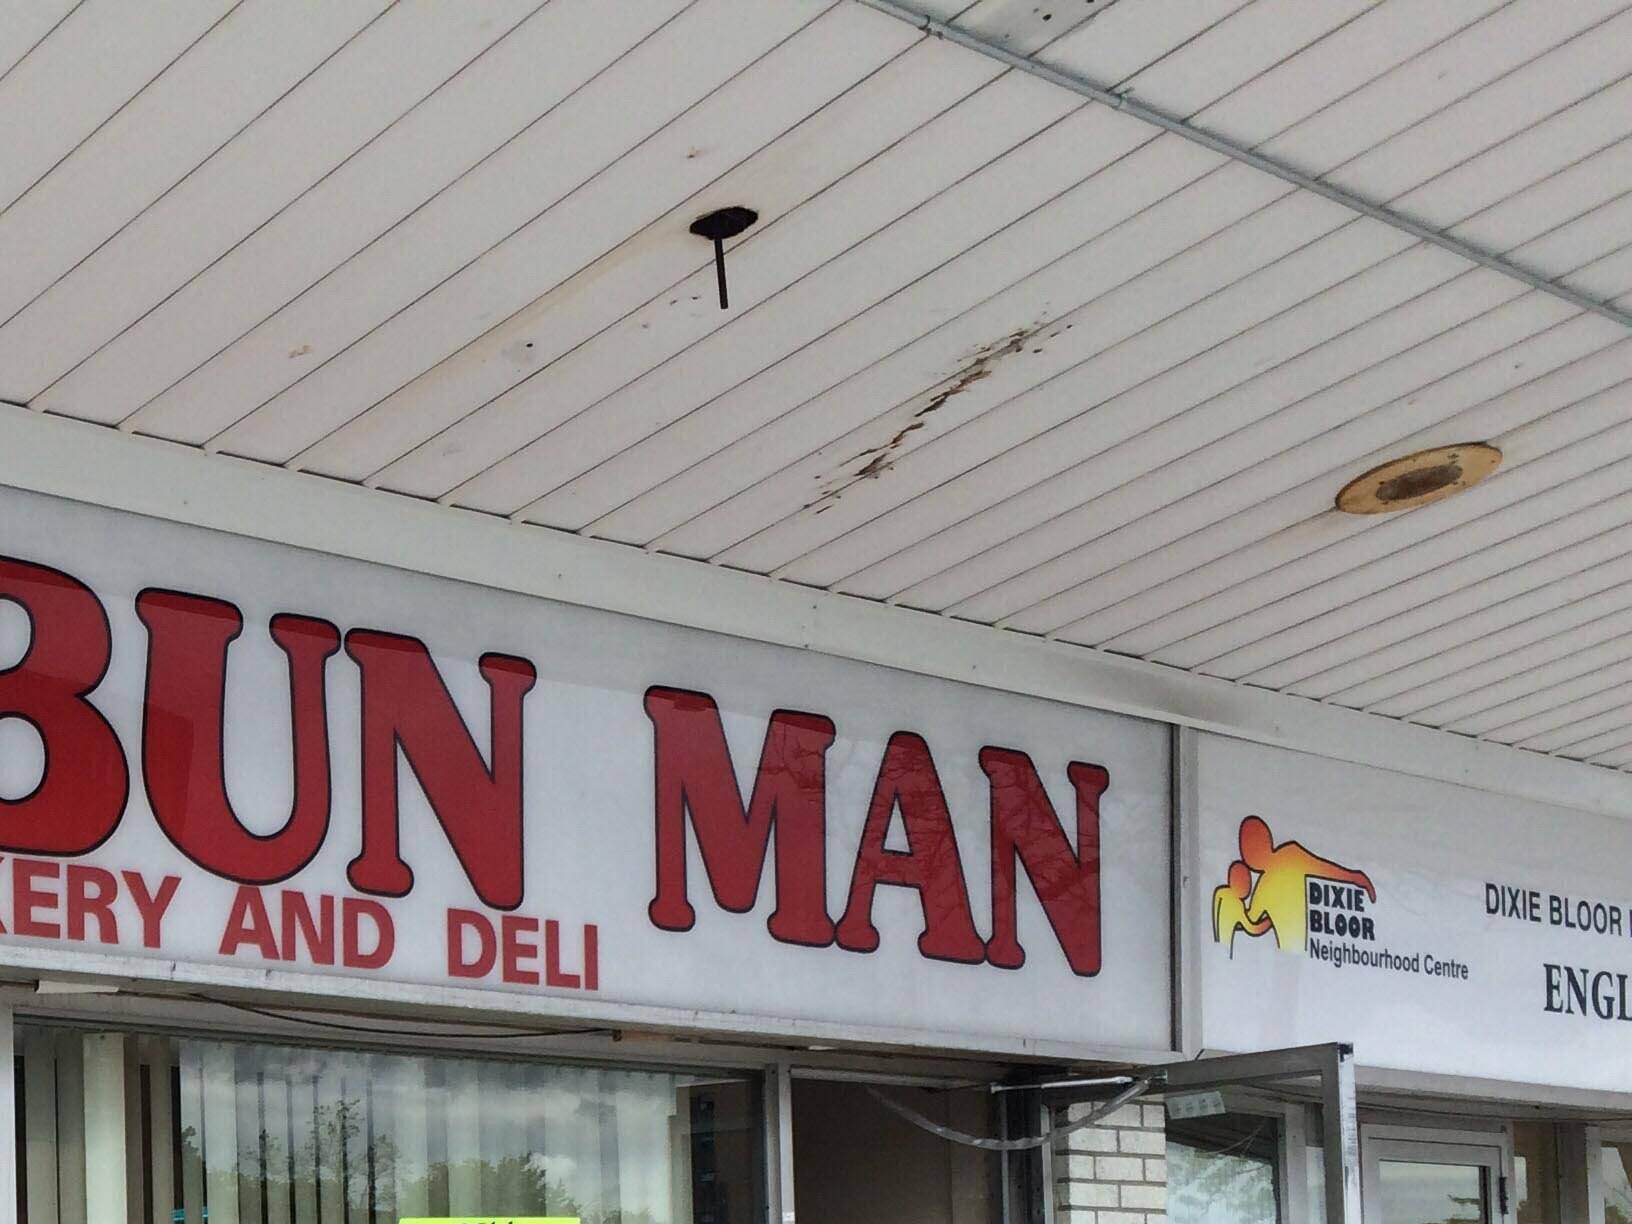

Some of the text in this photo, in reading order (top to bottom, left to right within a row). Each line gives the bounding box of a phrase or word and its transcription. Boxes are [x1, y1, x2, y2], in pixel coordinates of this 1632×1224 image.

[644, 685, 1110, 978] MAN
[1309, 881, 1365, 913] DIXIE
[1485, 882, 1542, 923] DIXIE
[1549, 895, 1623, 937] BLOOR
[219, 886, 395, 969] AND
[448, 909, 599, 989] DELI
[1309, 909, 1375, 942] BLOOR
[1309, 937, 1469, 980] Neighbourhood Centre
